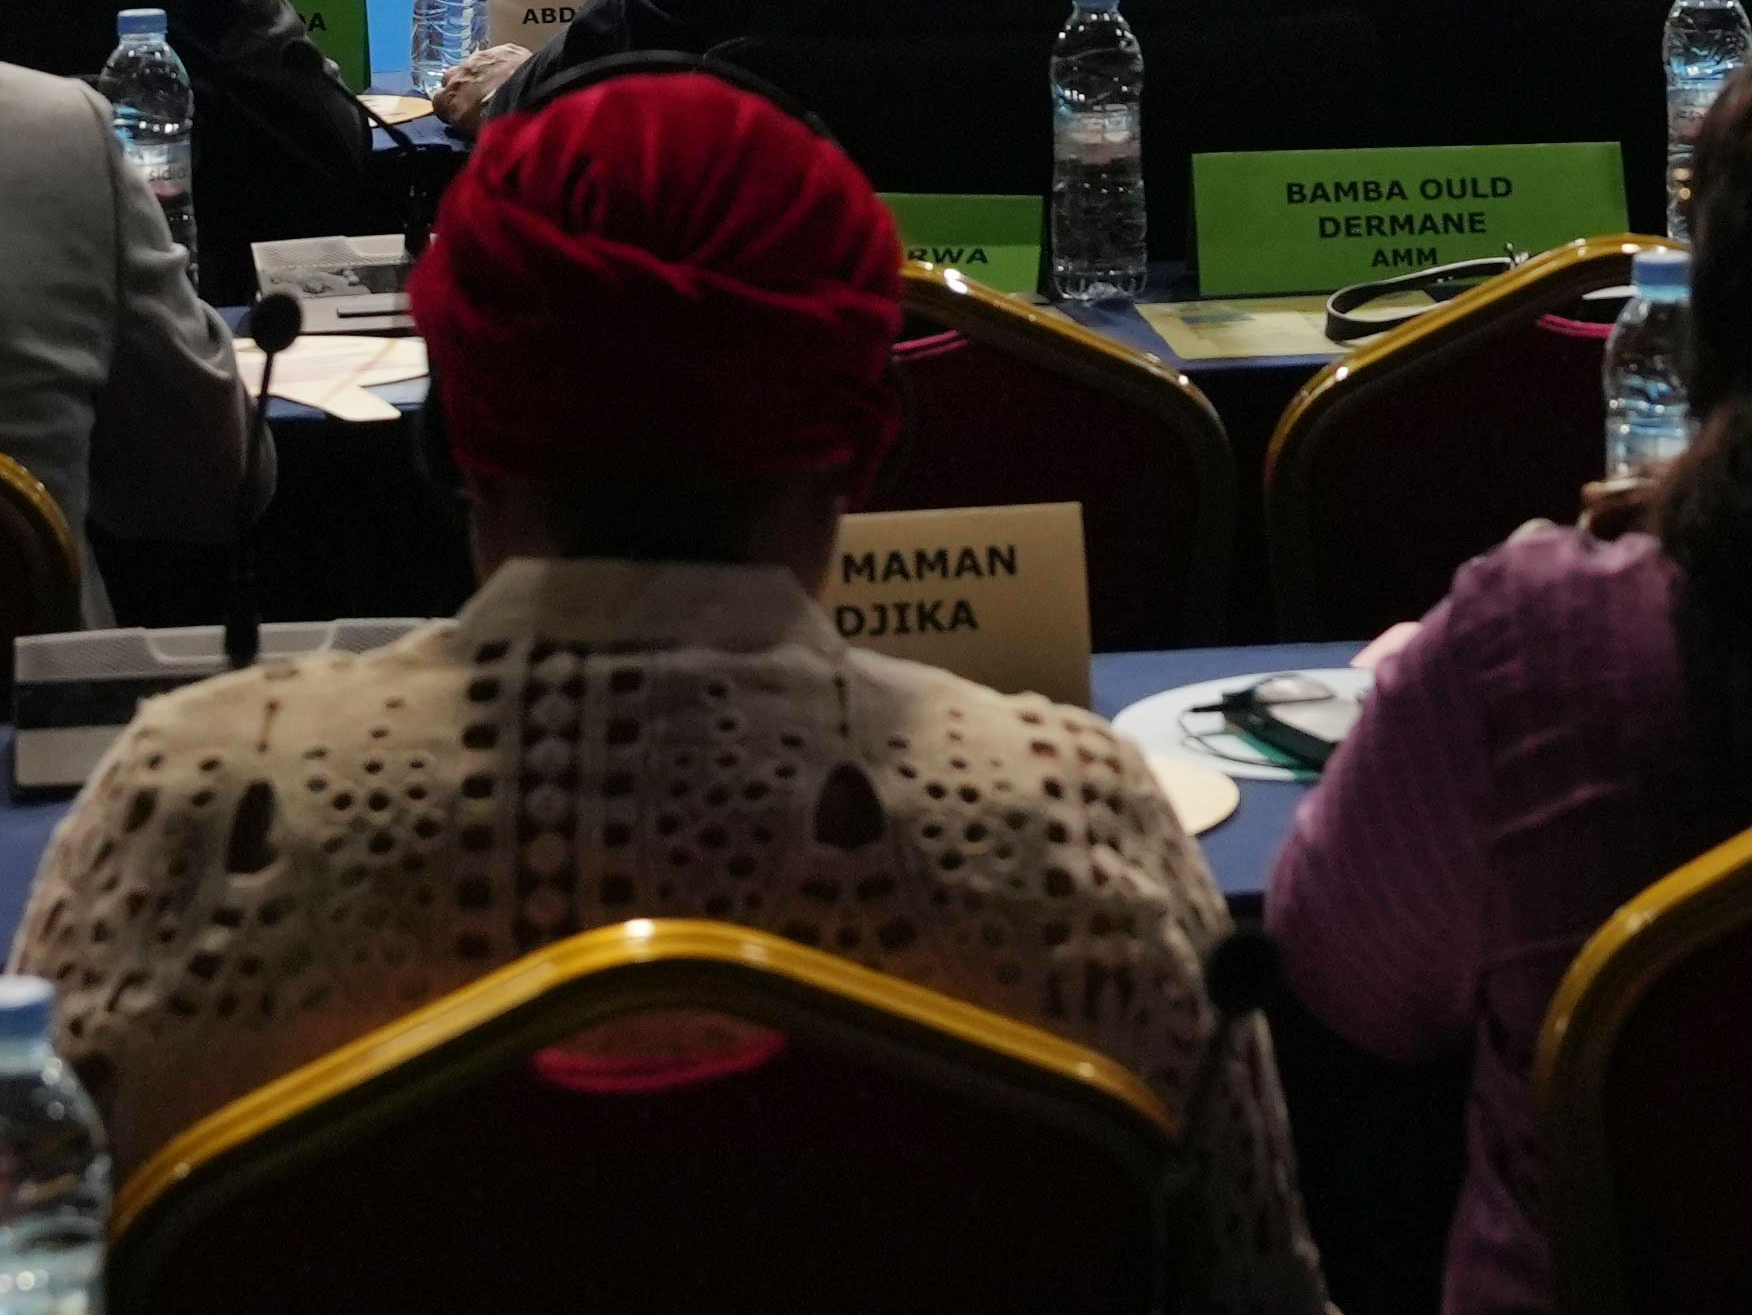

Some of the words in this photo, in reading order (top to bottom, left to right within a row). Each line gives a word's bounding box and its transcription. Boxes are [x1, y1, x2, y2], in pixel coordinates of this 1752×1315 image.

[1286, 182, 1409, 207] BAMBA
[1419, 177, 1513, 202] OULD
[1318, 212, 1487, 240] DERMANE
[1372, 246, 1439, 268] AMM
[841, 544, 1016, 584] MAMAN
